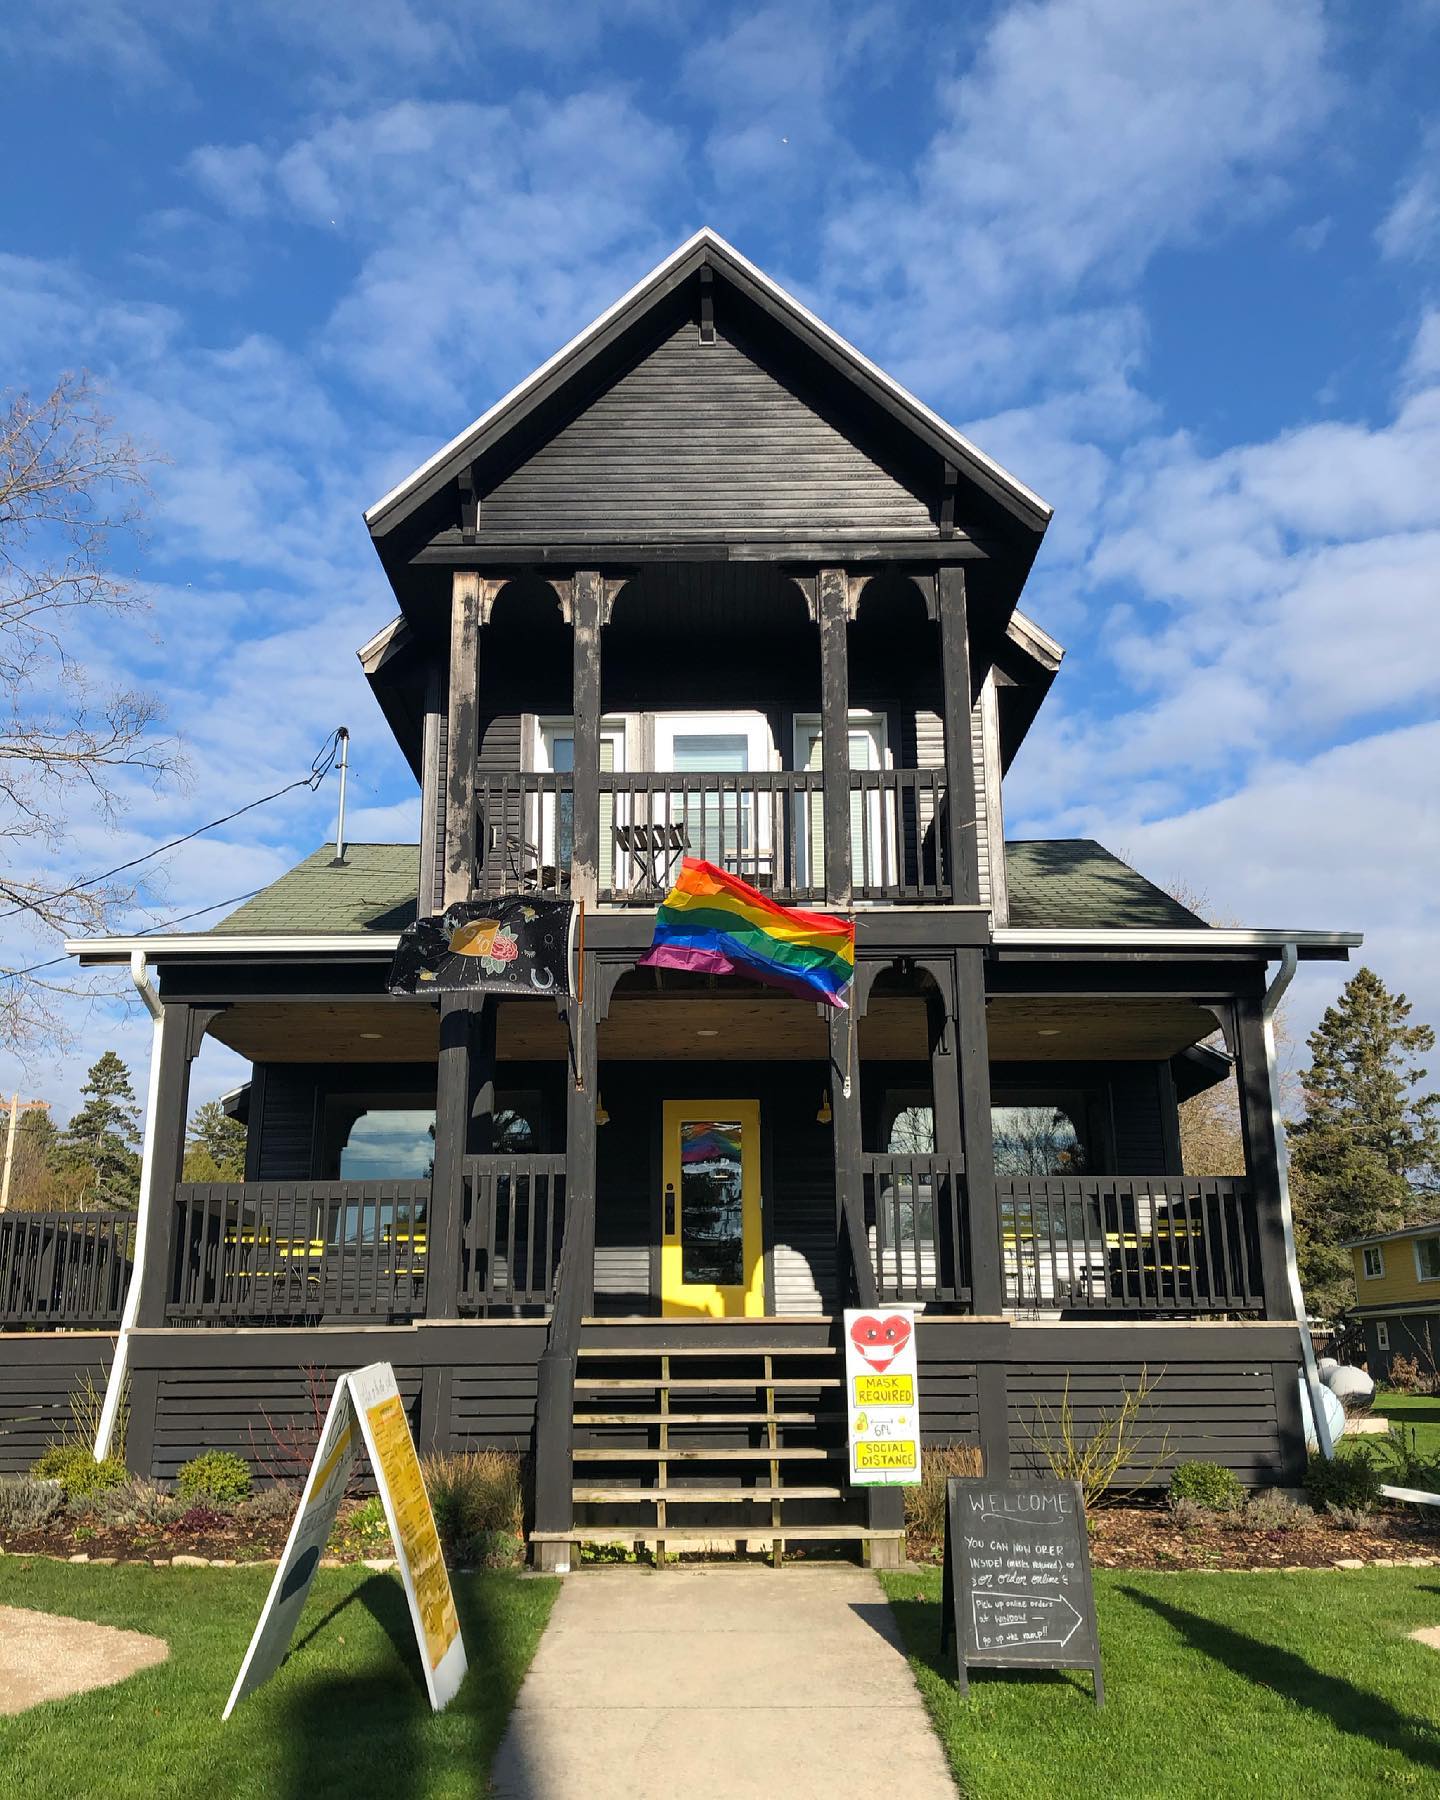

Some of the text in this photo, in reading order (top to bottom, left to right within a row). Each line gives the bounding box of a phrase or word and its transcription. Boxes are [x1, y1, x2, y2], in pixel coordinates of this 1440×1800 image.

[866, 1378, 898, 1388] MASK
[859, 1390, 911, 1402] REQUIRED
[866, 1443, 906, 1453] SOCIAL
[862, 1454, 912, 1466] DISTANCE
[969, 1494, 1072, 1513] WELCOME
[964, 1536, 985, 1549] YOU
[990, 1541, 1009, 1551] CAN
